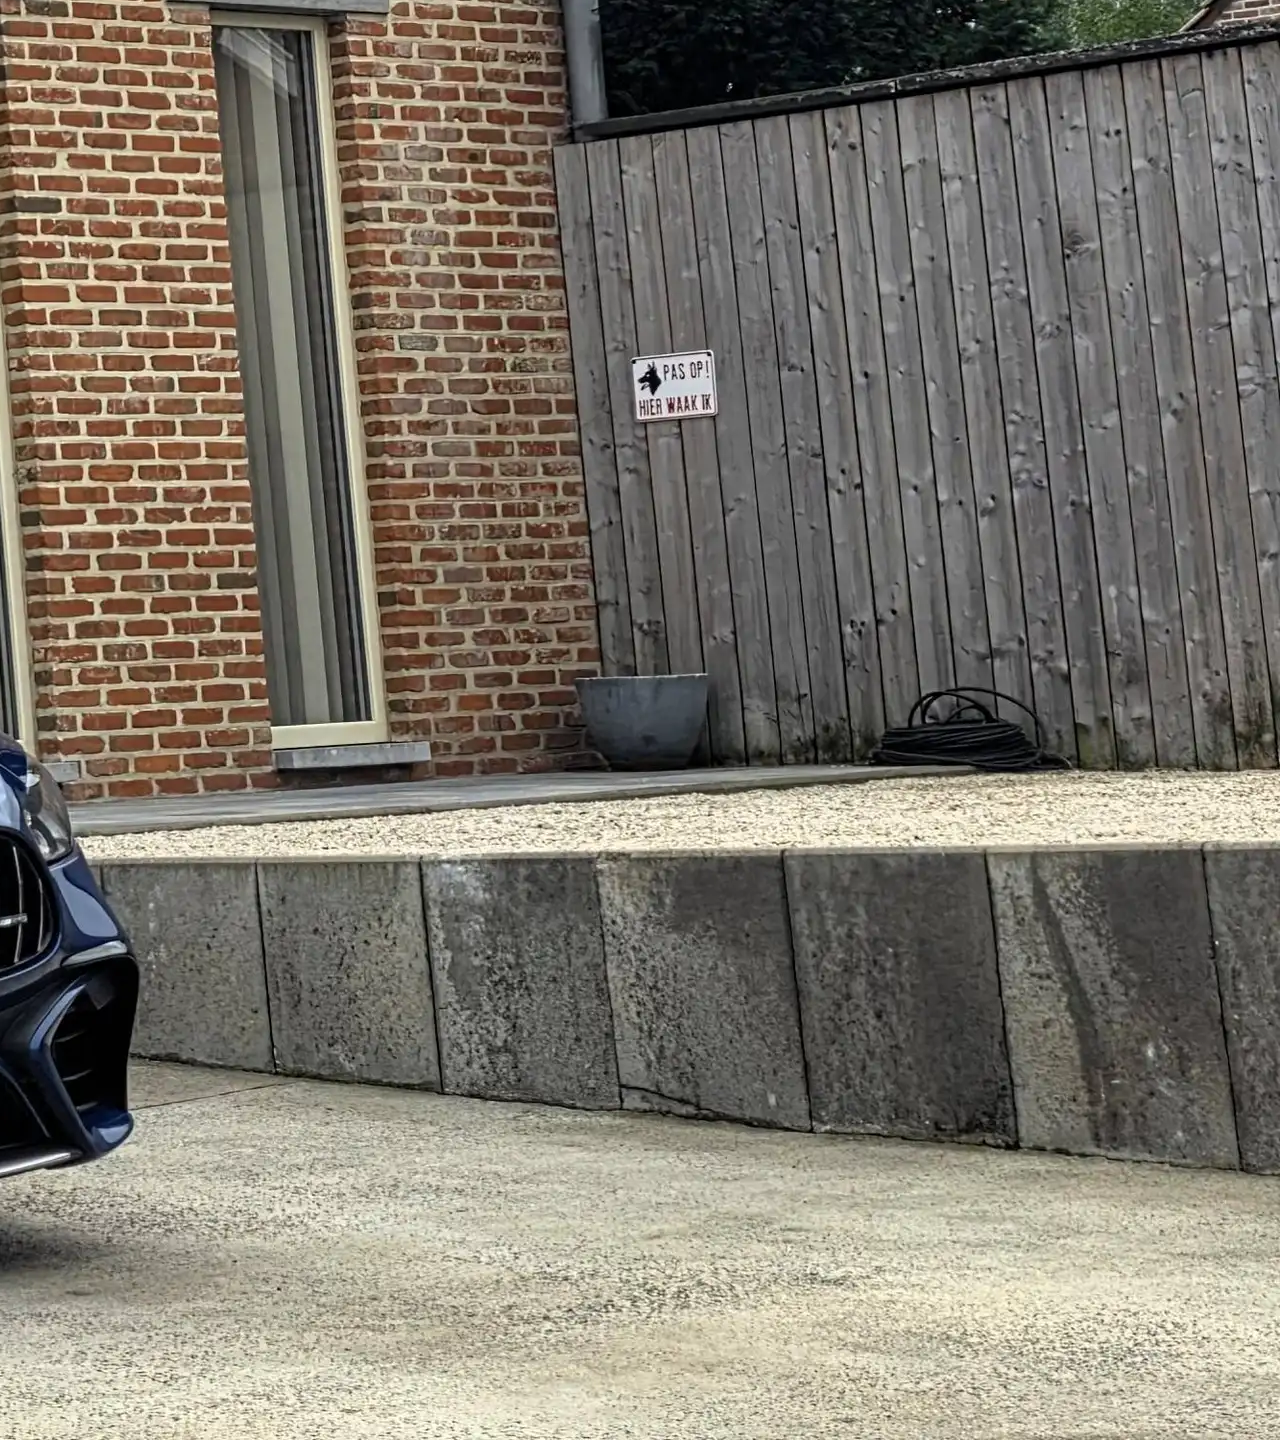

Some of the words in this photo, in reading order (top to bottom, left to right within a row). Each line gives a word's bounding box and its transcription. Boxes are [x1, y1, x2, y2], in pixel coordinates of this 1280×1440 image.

[663, 363, 686, 381] PAS
[639, 398, 663, 417] HIER
[666, 394, 698, 414] WAAK
[701, 393, 712, 411] IK
